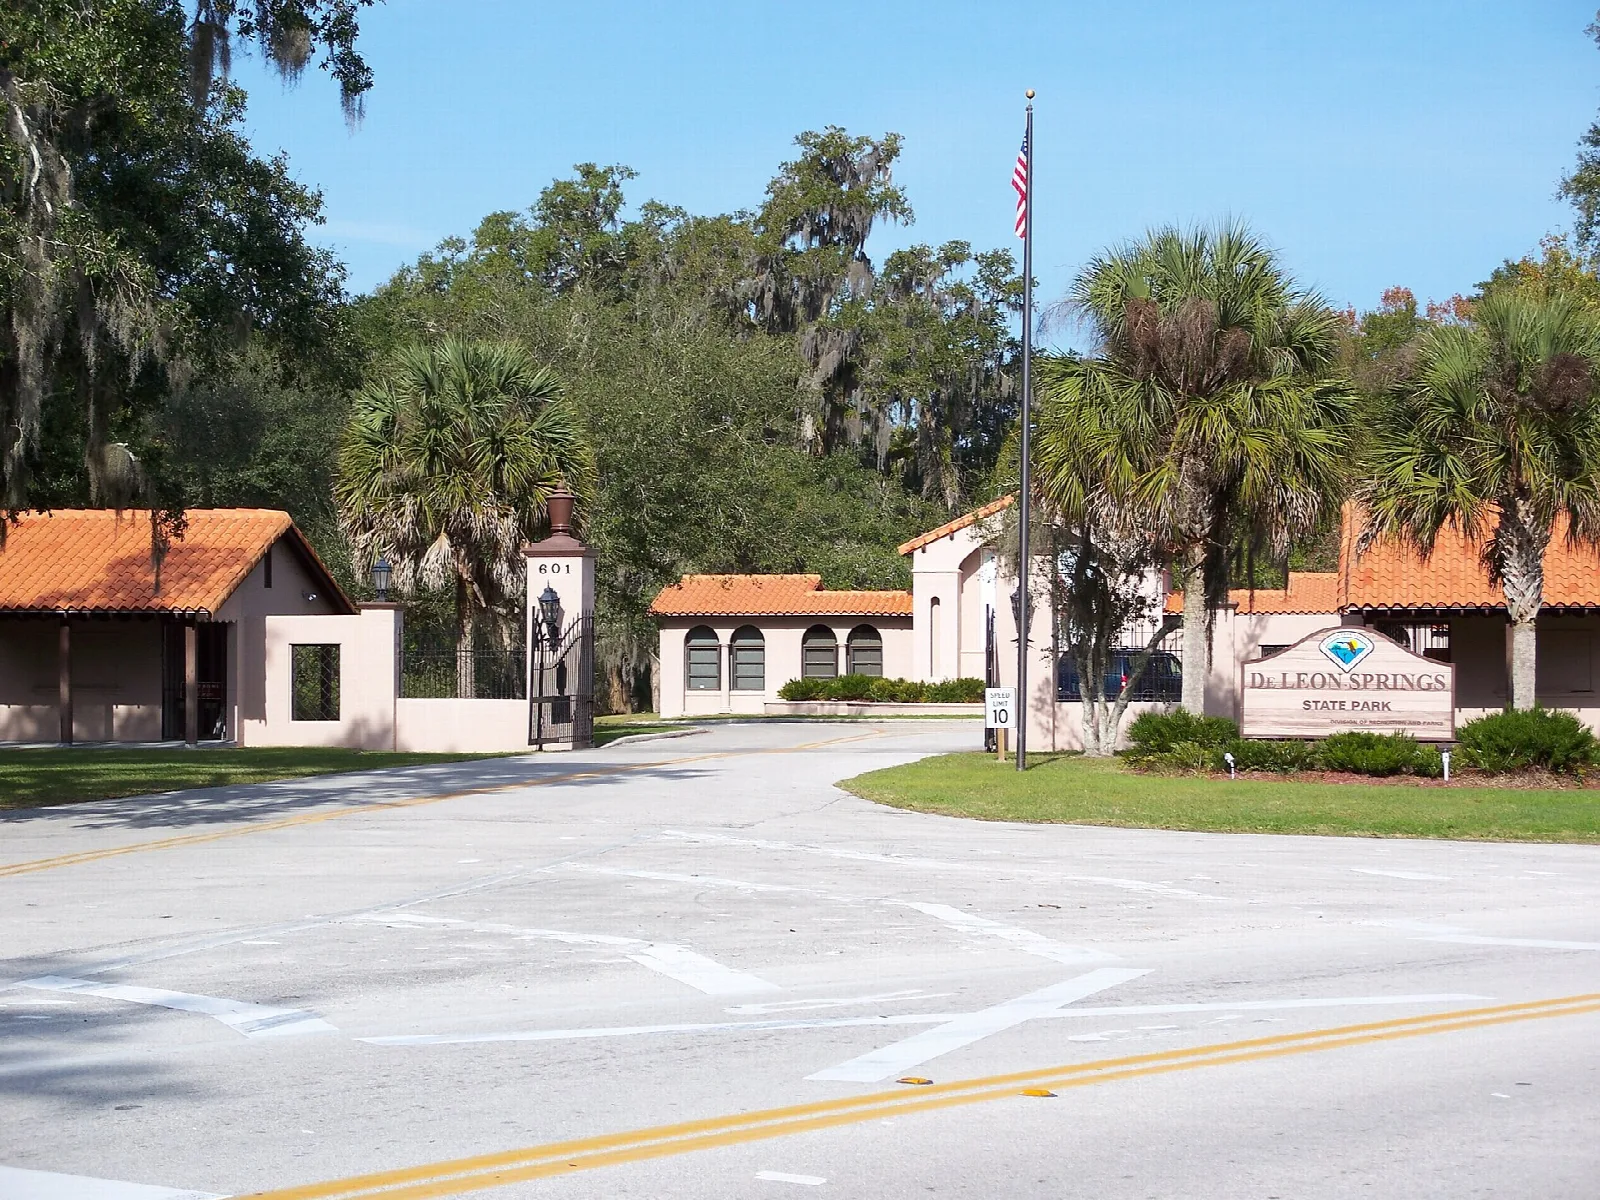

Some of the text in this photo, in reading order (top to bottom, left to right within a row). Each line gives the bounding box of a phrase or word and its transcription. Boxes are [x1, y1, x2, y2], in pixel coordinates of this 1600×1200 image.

[538, 563, 571, 574] 601
[1281, 672, 1343, 690] LEON
[1349, 673, 1446, 691] SPRINGS
[1302, 700, 1392, 712] STATE PARK
[992, 708, 1009, 724] 10
